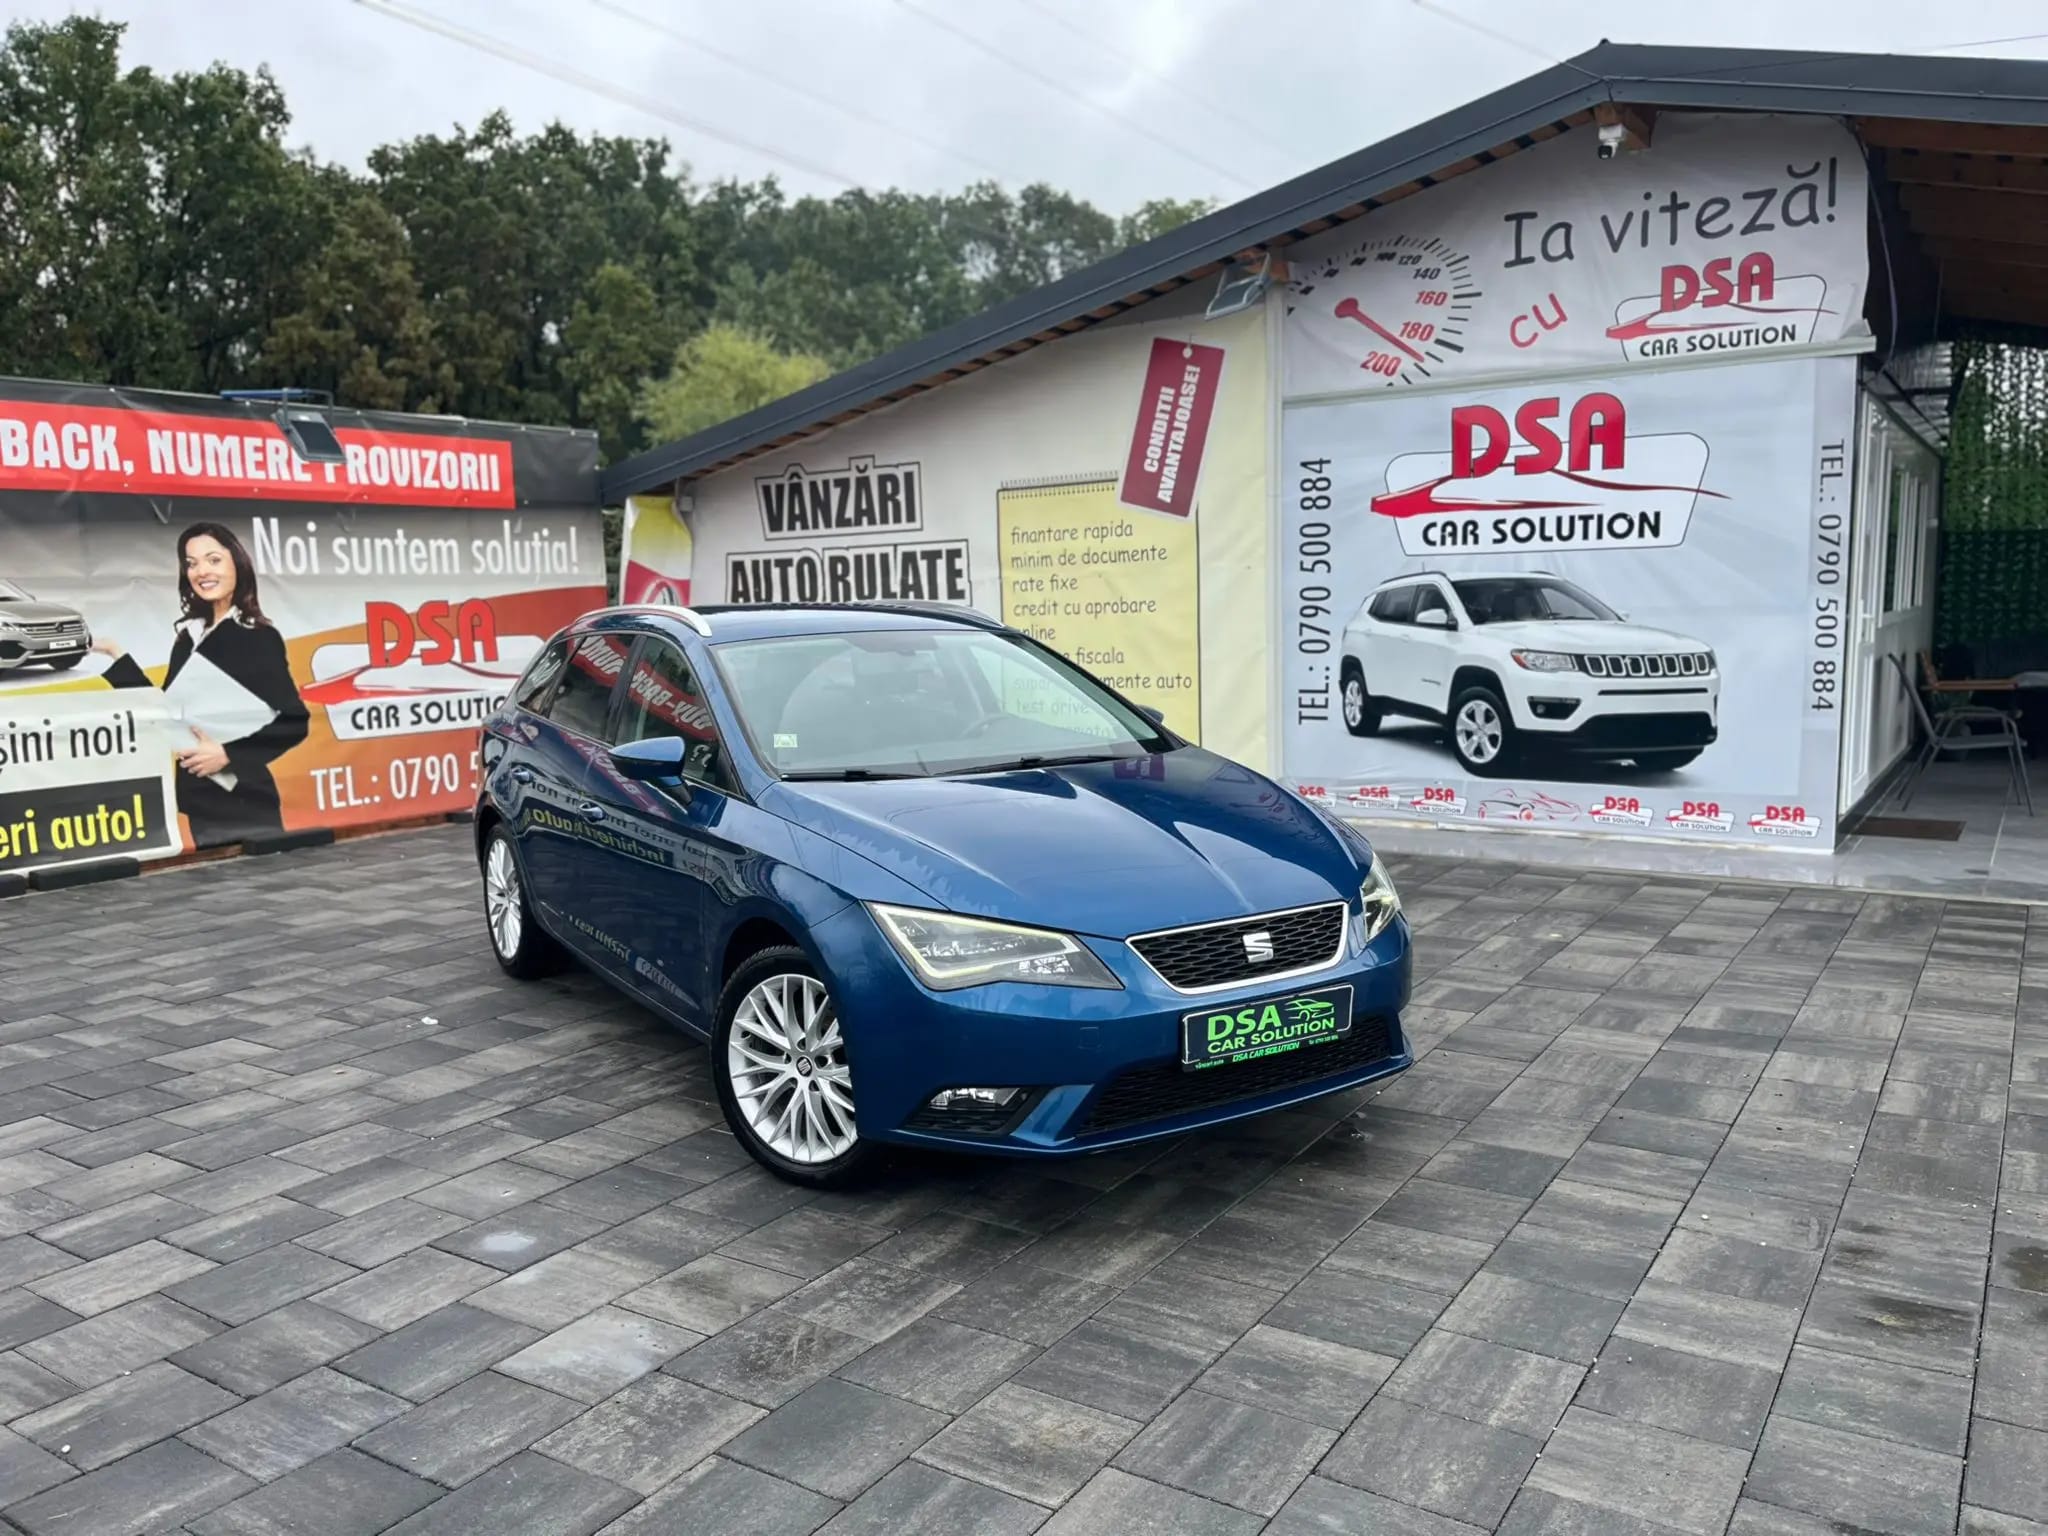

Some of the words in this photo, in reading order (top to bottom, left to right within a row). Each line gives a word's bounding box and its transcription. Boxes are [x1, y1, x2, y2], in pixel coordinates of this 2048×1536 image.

[1504, 211, 1574, 268] Ia
[1601, 157, 1837, 253] viteză!
[1397, 254, 1423, 266] 120
[1412, 267, 1441, 280] 140
[1414, 291, 1448, 307] 160
[1661, 252, 1774, 312] DSA
[1398, 321, 1435, 342] 180
[1510, 293, 1568, 348] cu
[1639, 339, 1679, 357] CAR
[1685, 324, 1797, 353] SOLUTION
[1360, 351, 1401, 377] 200
[0, 418, 135, 476] BACK,
[1143, 386, 1176, 473] CONDITII
[1156, 364, 1201, 504] AVANTAJOASE!
[1452, 392, 1627, 479] DSA
[1299, 457, 1332, 511] 884
[1818, 437, 1845, 503] TEL.:
[762, 463, 917, 533] VÂNZĂRI
[1011, 526, 1079, 545] finantare
[1083, 519, 1134, 543] rapida
[1421, 519, 1480, 547] CAR
[1492, 509, 1662, 544] SOLUTION
[252, 517, 320, 575] Noi
[332, 528, 460, 576] suntem
[471, 519, 579, 585] soluția!
[1011, 551, 1054, 569] minim
[1058, 548, 1078, 566] de
[1081, 545, 1168, 566] documente
[1299, 522, 1332, 574] 500
[1816, 514, 1843, 586] 0790
[730, 556, 820, 604] AUTO
[828, 548, 967, 604] RULATE
[1012, 576, 1046, 593] rate
[1049, 574, 1079, 592] fixe
[1013, 600, 1059, 618] credit
[1063, 603, 1082, 616] cu
[1084, 597, 1157, 619] aprobare
[1298, 586, 1332, 654] 0790
[1813, 597, 1839, 649] 500
[364, 597, 499, 669] DSA
[1018, 624, 1057, 641] nline
[1075, 646, 1126, 666] fiscala
[1101, 673, 1152, 690] mente
[1156, 675, 1193, 690] auto
[1298, 665, 1331, 725] TEL.:
[1811, 660, 1837, 711] 884
[70, 710, 138, 758] noi!
[351, 704, 400, 731] CAR
[310, 765, 381, 811] TEL.:
[389, 752, 460, 800] 0790
[1359, 786, 1389, 798] DSA
[1424, 787, 1455, 802] DSA
[51, 793, 146, 851] auto!
[1604, 796, 1639, 813] DSA
[1613, 816, 1646, 826] SOLUTION
[1683, 801, 1720, 817] DSA
[1766, 805, 1805, 822] DSA
[1691, 822, 1727, 831] SOLUTION
[1775, 828, 1813, 837] SOLUTION
[1207, 1035, 1245, 1054] CAR
[1250, 1017, 1335, 1046] SOLUTION
[1208, 1004, 1282, 1041] DSA
[1232, 1053, 1249, 1063] DSA
[1249, 1049, 1265, 1059] CAR
[1264, 1041, 1300, 1056] SOLUTION
